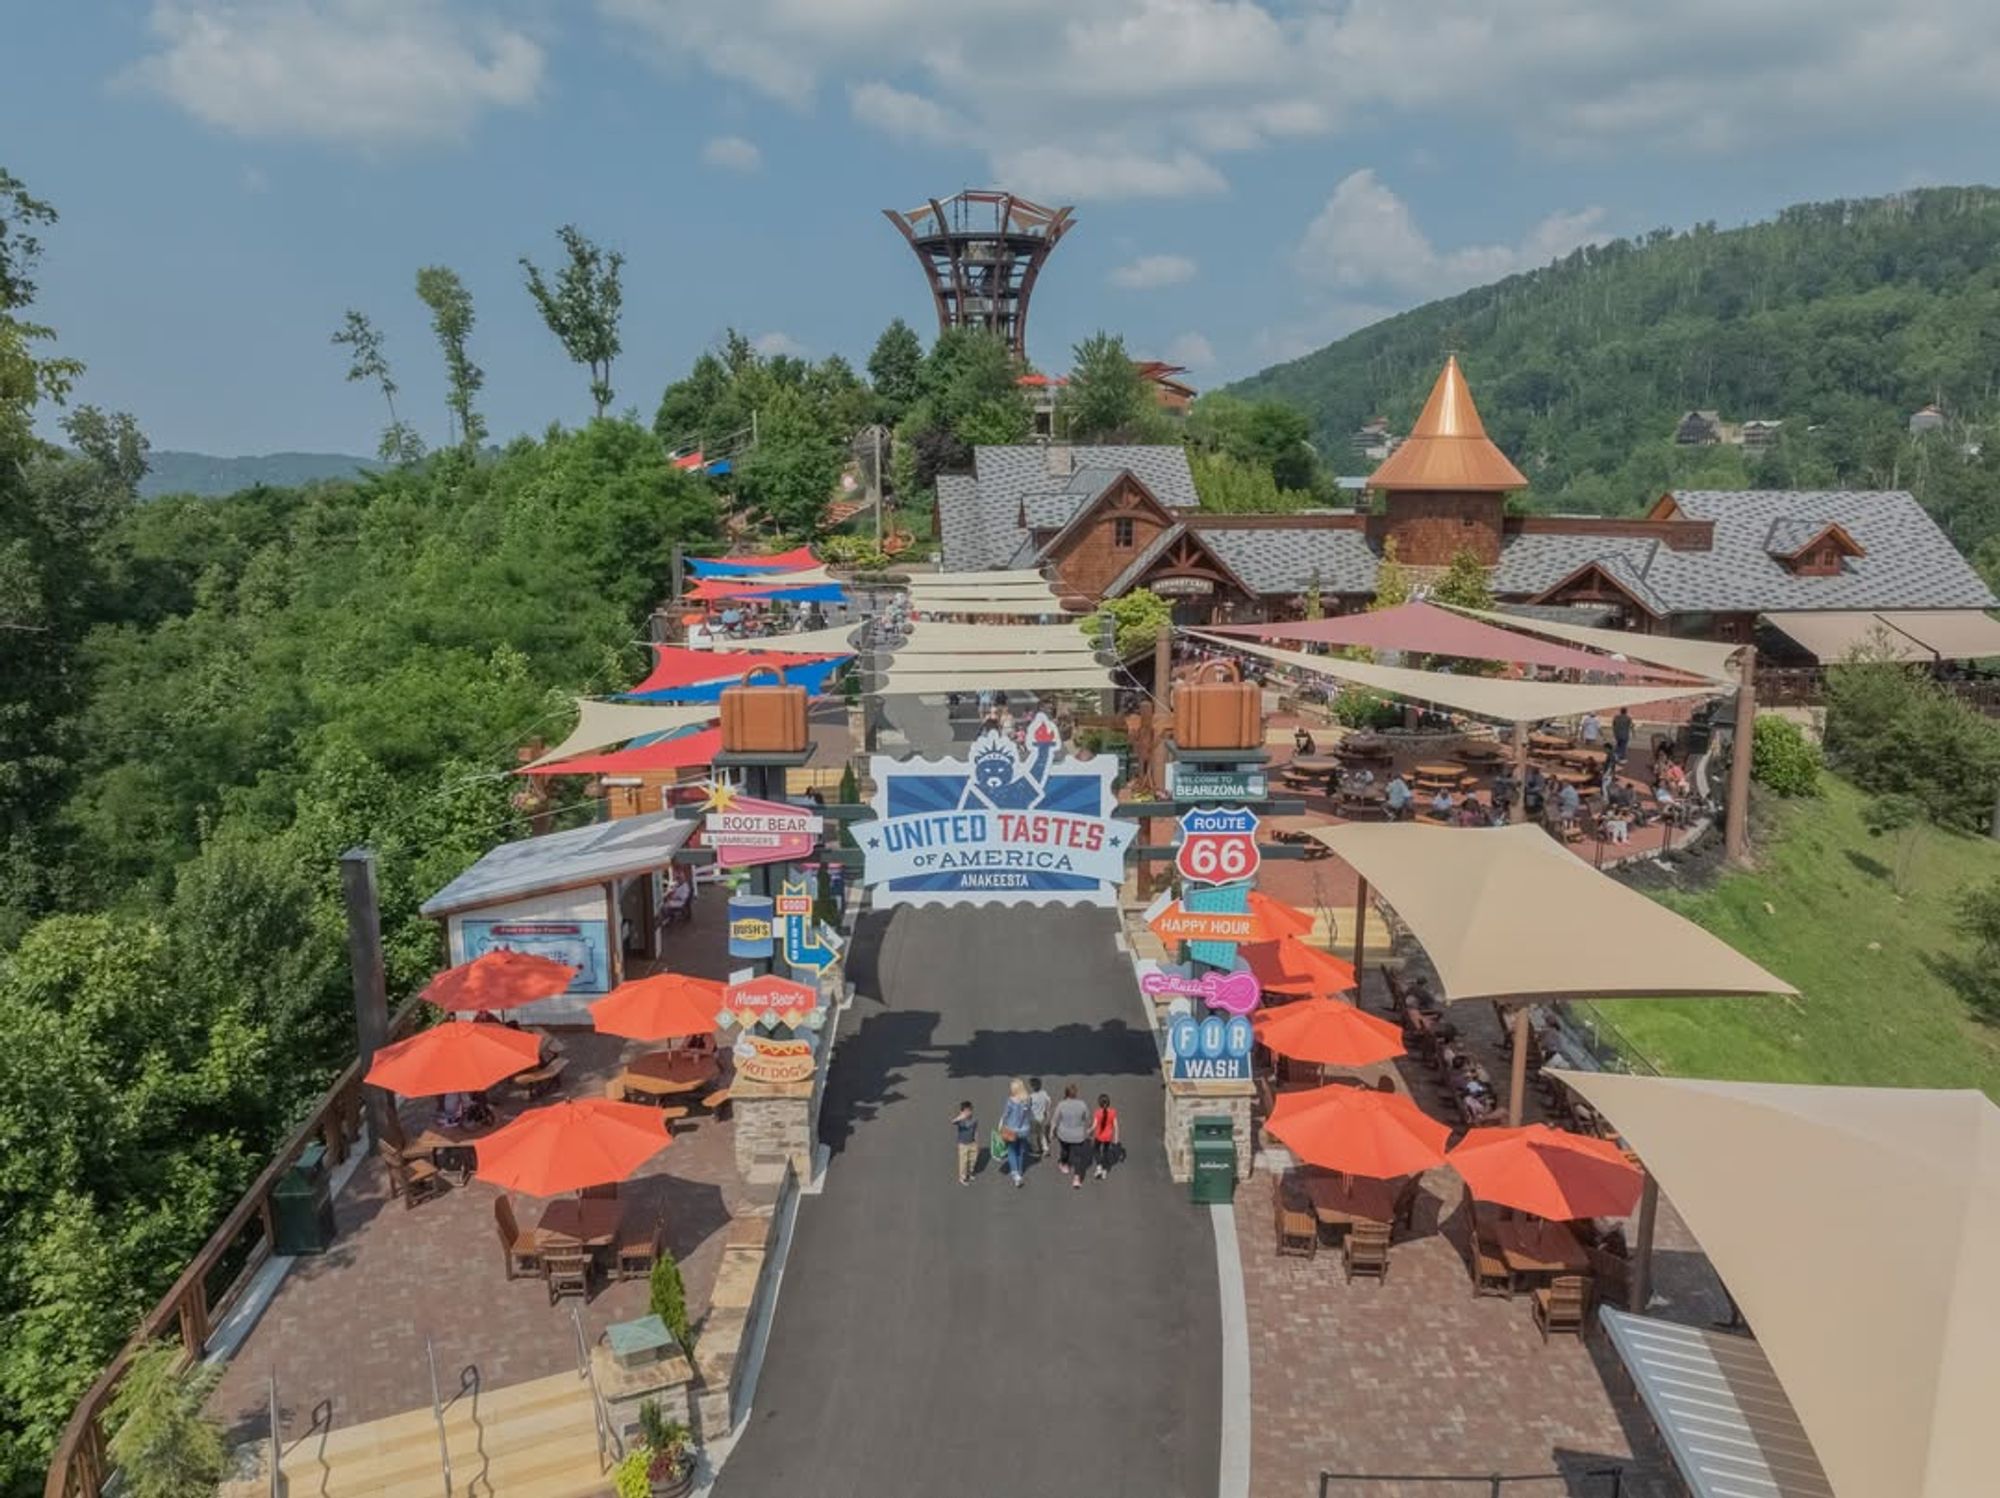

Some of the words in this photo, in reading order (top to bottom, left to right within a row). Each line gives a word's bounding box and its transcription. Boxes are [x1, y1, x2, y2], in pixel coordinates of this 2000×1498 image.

[1176, 776, 1220, 784] WELCOME
[1222, 776, 1233, 784] TO
[1176, 785, 1245, 796] BEARIZONA
[722, 816, 763, 830] ROOT
[768, 818, 808, 831] BEAR
[1193, 817, 1246, 830] ROUTE
[884, 814, 987, 852] UNITED
[997, 813, 1105, 852] TASTES
[913, 853, 938, 867] OF
[939, 850, 1073, 871] AMERICA
[1190, 838, 1246, 874] 66
[960, 874, 1029, 888] ANAKEESTA
[732, 922, 770, 936] BUSH'S
[1160, 919, 1208, 933] HAPPY
[1211, 920, 1250, 935] HOUR
[1180, 1026, 1247, 1051] FUR
[741, 1058, 767, 1075] HOT
[1184, 1059, 1240, 1078] WASH
